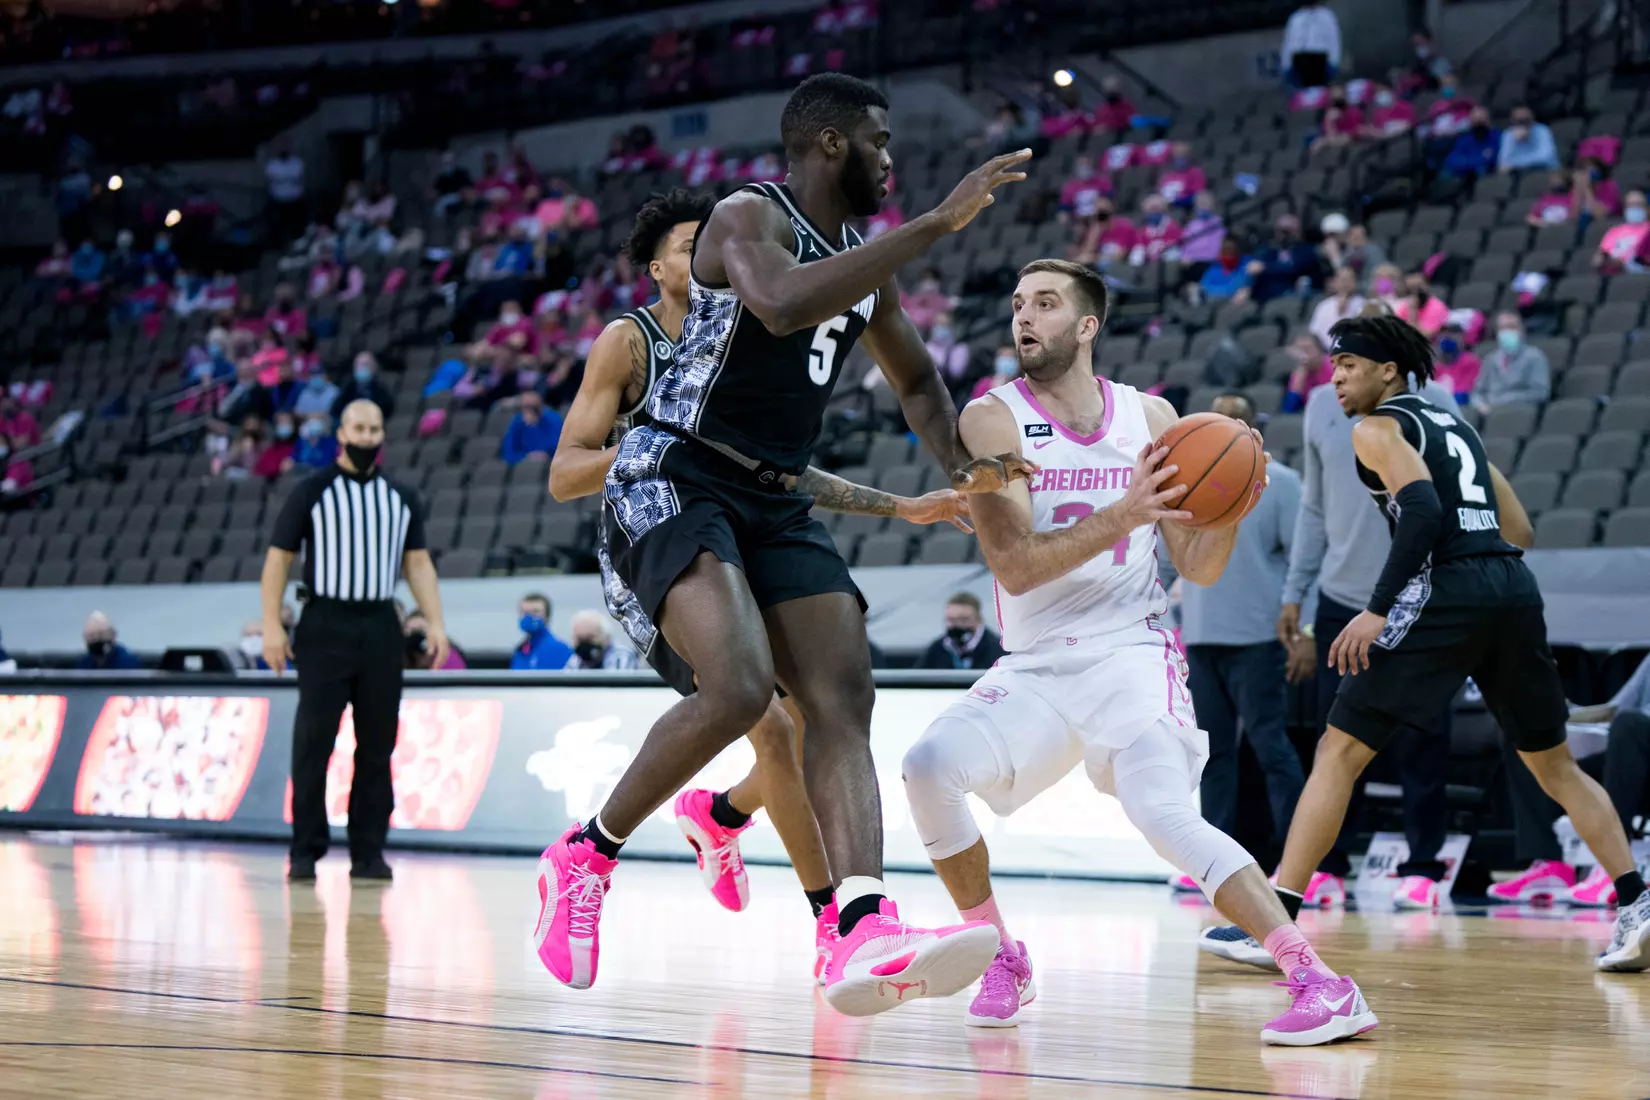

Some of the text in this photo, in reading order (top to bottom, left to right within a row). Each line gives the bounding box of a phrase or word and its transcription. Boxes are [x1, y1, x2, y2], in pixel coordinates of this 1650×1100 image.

[808, 314, 848, 386] 5
[1029, 467, 1133, 492] CREIGHTO
[1445, 431, 1487, 504] 2
